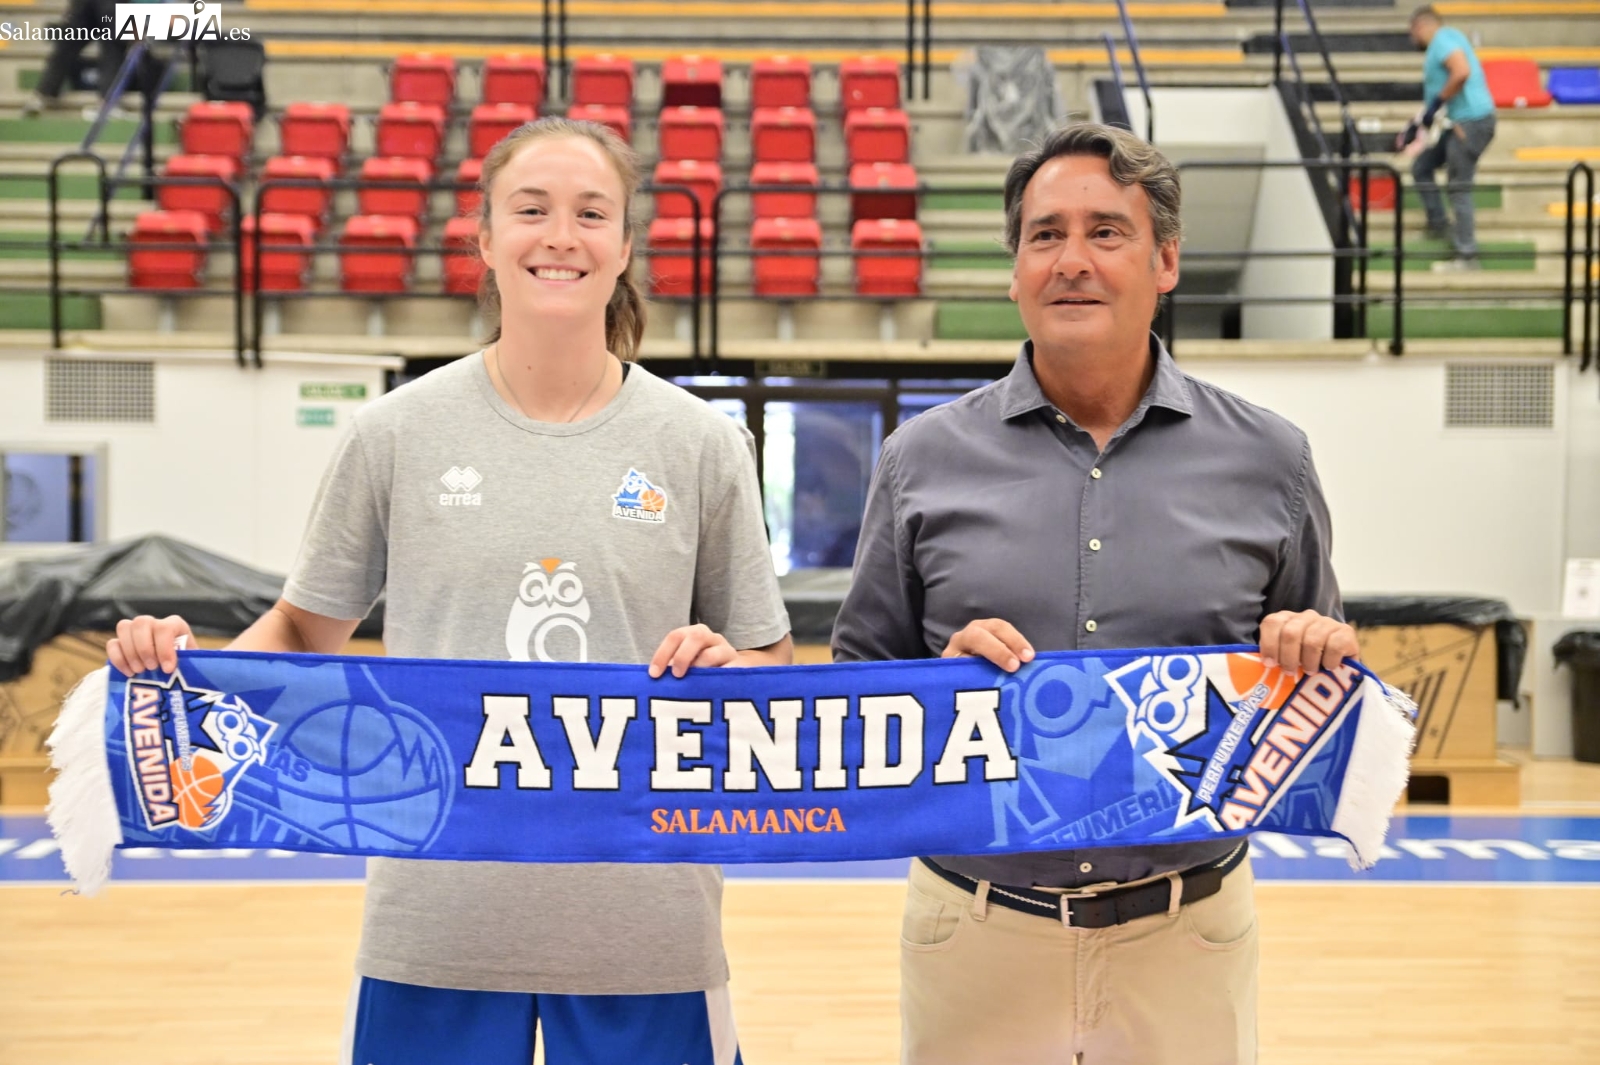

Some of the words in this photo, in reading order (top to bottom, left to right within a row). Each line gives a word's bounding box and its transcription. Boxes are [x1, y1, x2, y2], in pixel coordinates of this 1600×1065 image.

[615, 505, 663, 521] AVENIDA
[132, 687, 178, 821] AVENIDA
[463, 688, 1018, 792] AVENIDA
[652, 806, 846, 835] SALAMANCA
